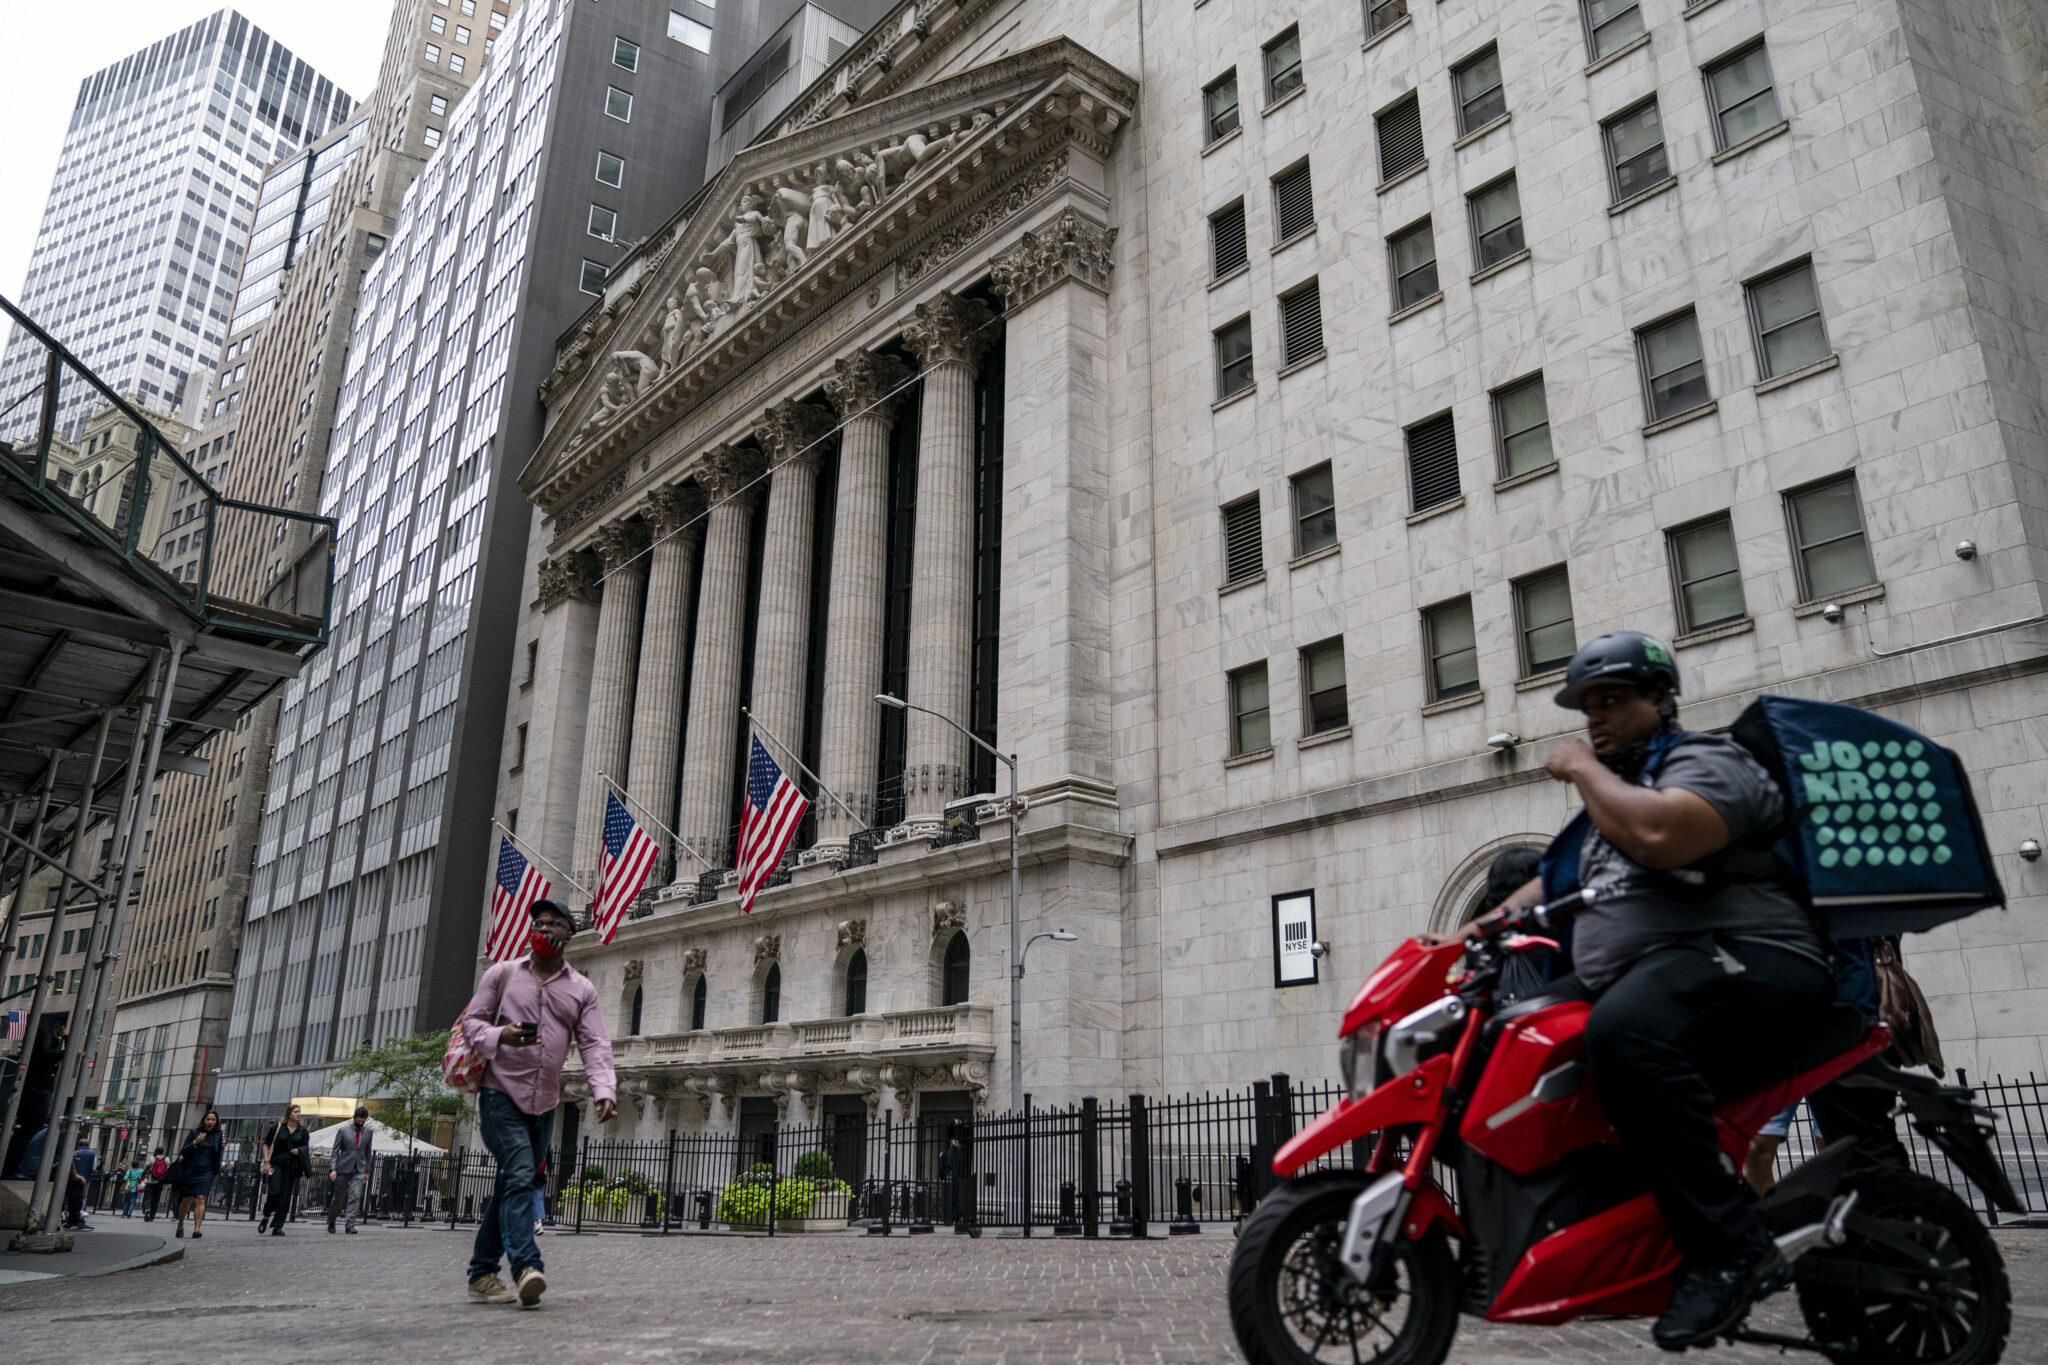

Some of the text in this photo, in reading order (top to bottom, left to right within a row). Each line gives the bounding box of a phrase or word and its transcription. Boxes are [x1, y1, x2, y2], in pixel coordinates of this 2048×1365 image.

[658, 305, 855, 461] NEW YORK STOCK EXCHANGE
[1799, 741, 1862, 771] JO
[1802, 771, 1874, 802] KR
[1285, 940, 1308, 951] NYSE
